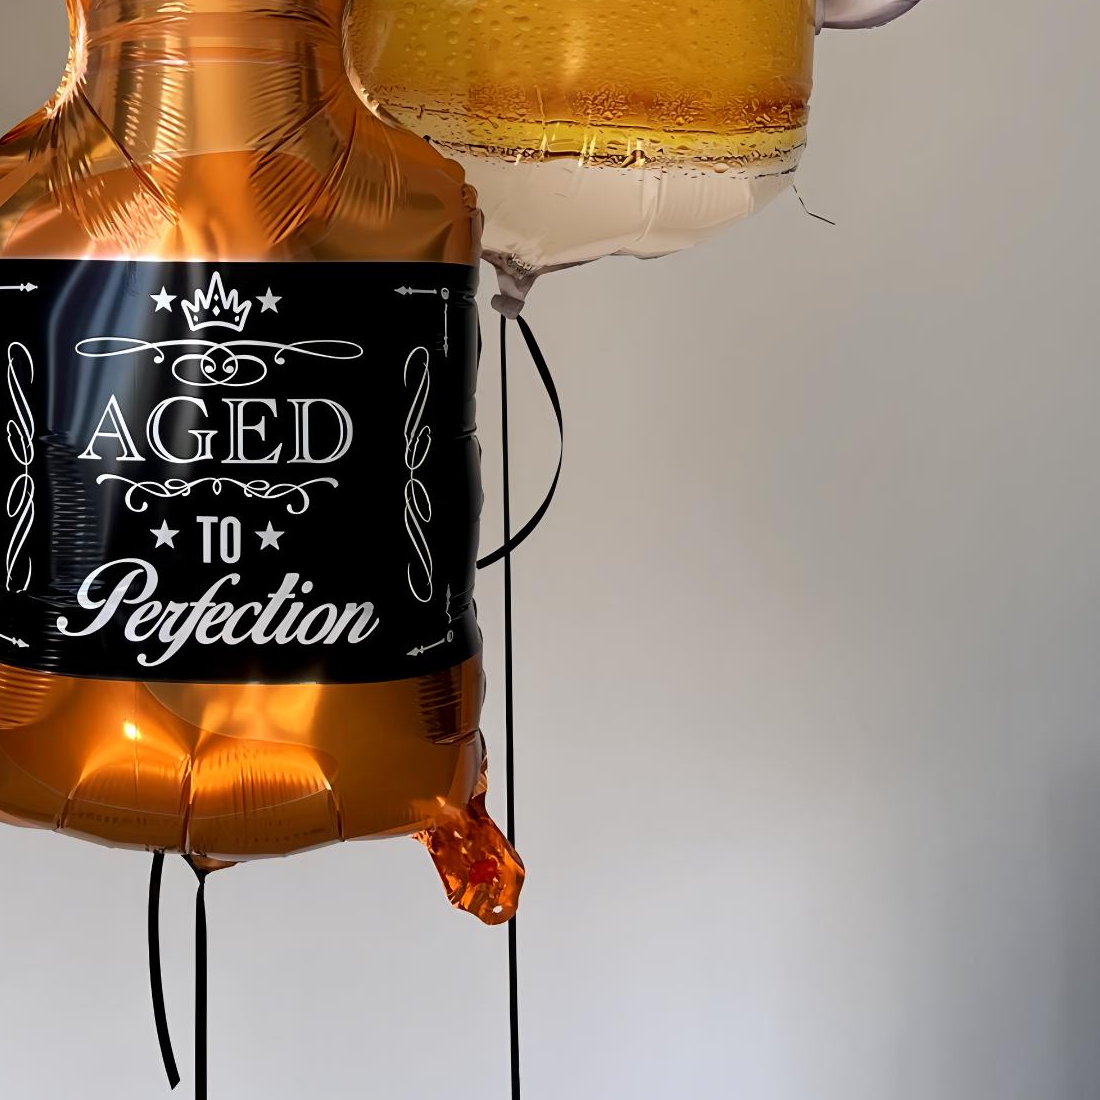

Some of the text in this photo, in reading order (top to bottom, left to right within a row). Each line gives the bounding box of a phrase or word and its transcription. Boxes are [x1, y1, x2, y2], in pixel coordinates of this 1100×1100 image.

[77, 393, 354, 464] AGED
[196, 515, 242, 564] TO
[56, 557, 380, 667] Perfection
